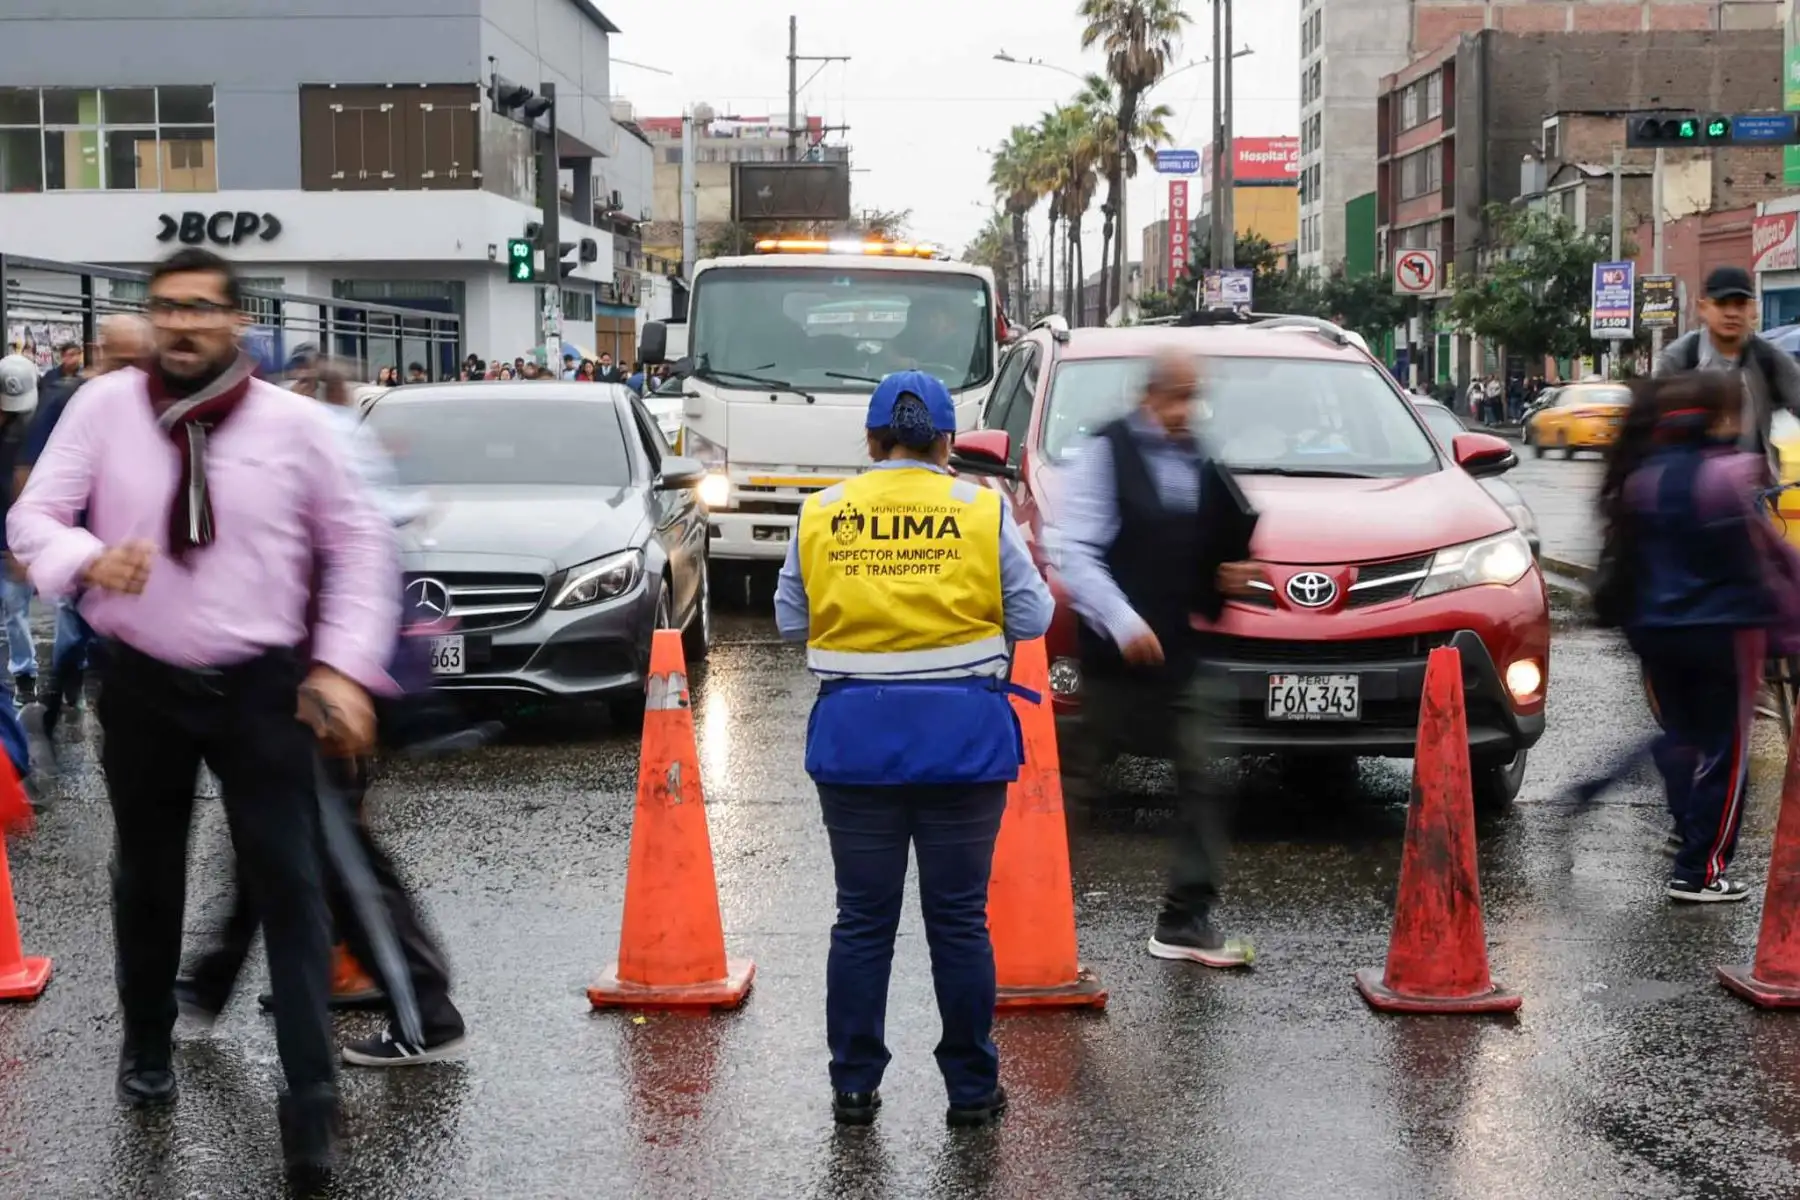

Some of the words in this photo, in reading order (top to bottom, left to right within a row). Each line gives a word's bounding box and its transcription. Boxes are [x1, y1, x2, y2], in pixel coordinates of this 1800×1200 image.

[1239, 150, 1287, 164] Hospital
[1172, 184, 1184, 278] SOLIDARI
[871, 506, 947, 514] MUNICIPALIDAD
[949, 506, 962, 514] DE
[871, 515, 961, 540] LIMA
[828, 549, 893, 562] INSPECTOR
[896, 548, 961, 561] MUNICIPAL
[845, 564, 860, 576] DE
[866, 563, 941, 576] TRANSPORTE
[1298, 676, 1330, 685] PERU
[1270, 686, 1355, 712] F6X-343
